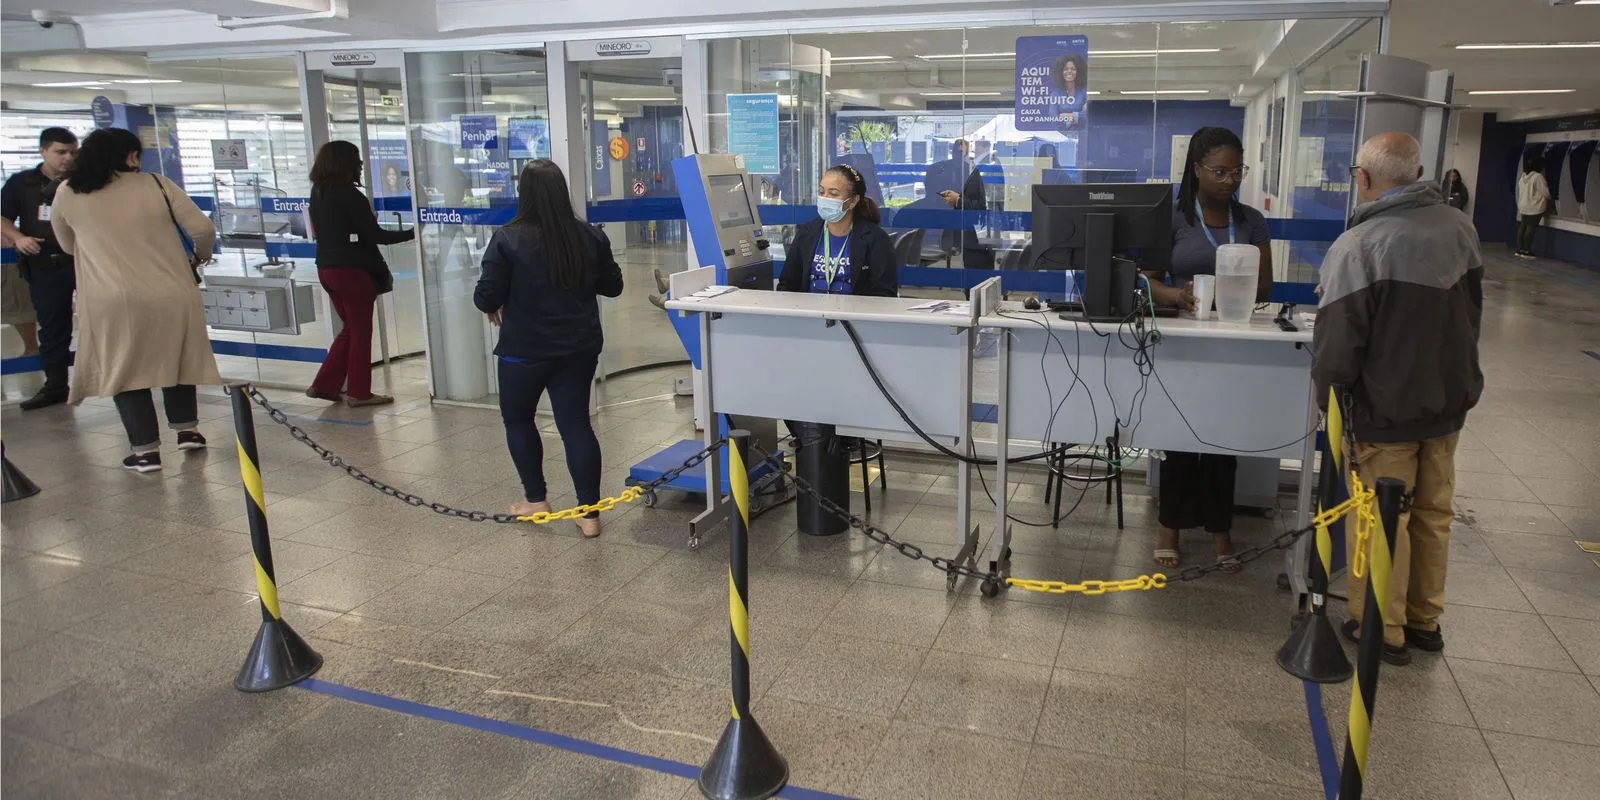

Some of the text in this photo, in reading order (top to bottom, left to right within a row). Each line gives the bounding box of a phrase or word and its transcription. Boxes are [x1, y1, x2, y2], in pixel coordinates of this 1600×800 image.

[599, 42, 632, 51] MINEORO
[1021, 67, 1050, 77] AQUI
[1021, 77, 1043, 86] TEM
[1021, 87, 1049, 96] WI-FI
[1021, 96, 1076, 105] GRATUITO
[462, 130, 495, 142] Penhor
[595, 145, 603, 170] Caixas
[1089, 192, 1115, 200] ThinkVision
[420, 209, 462, 223] Entrada
